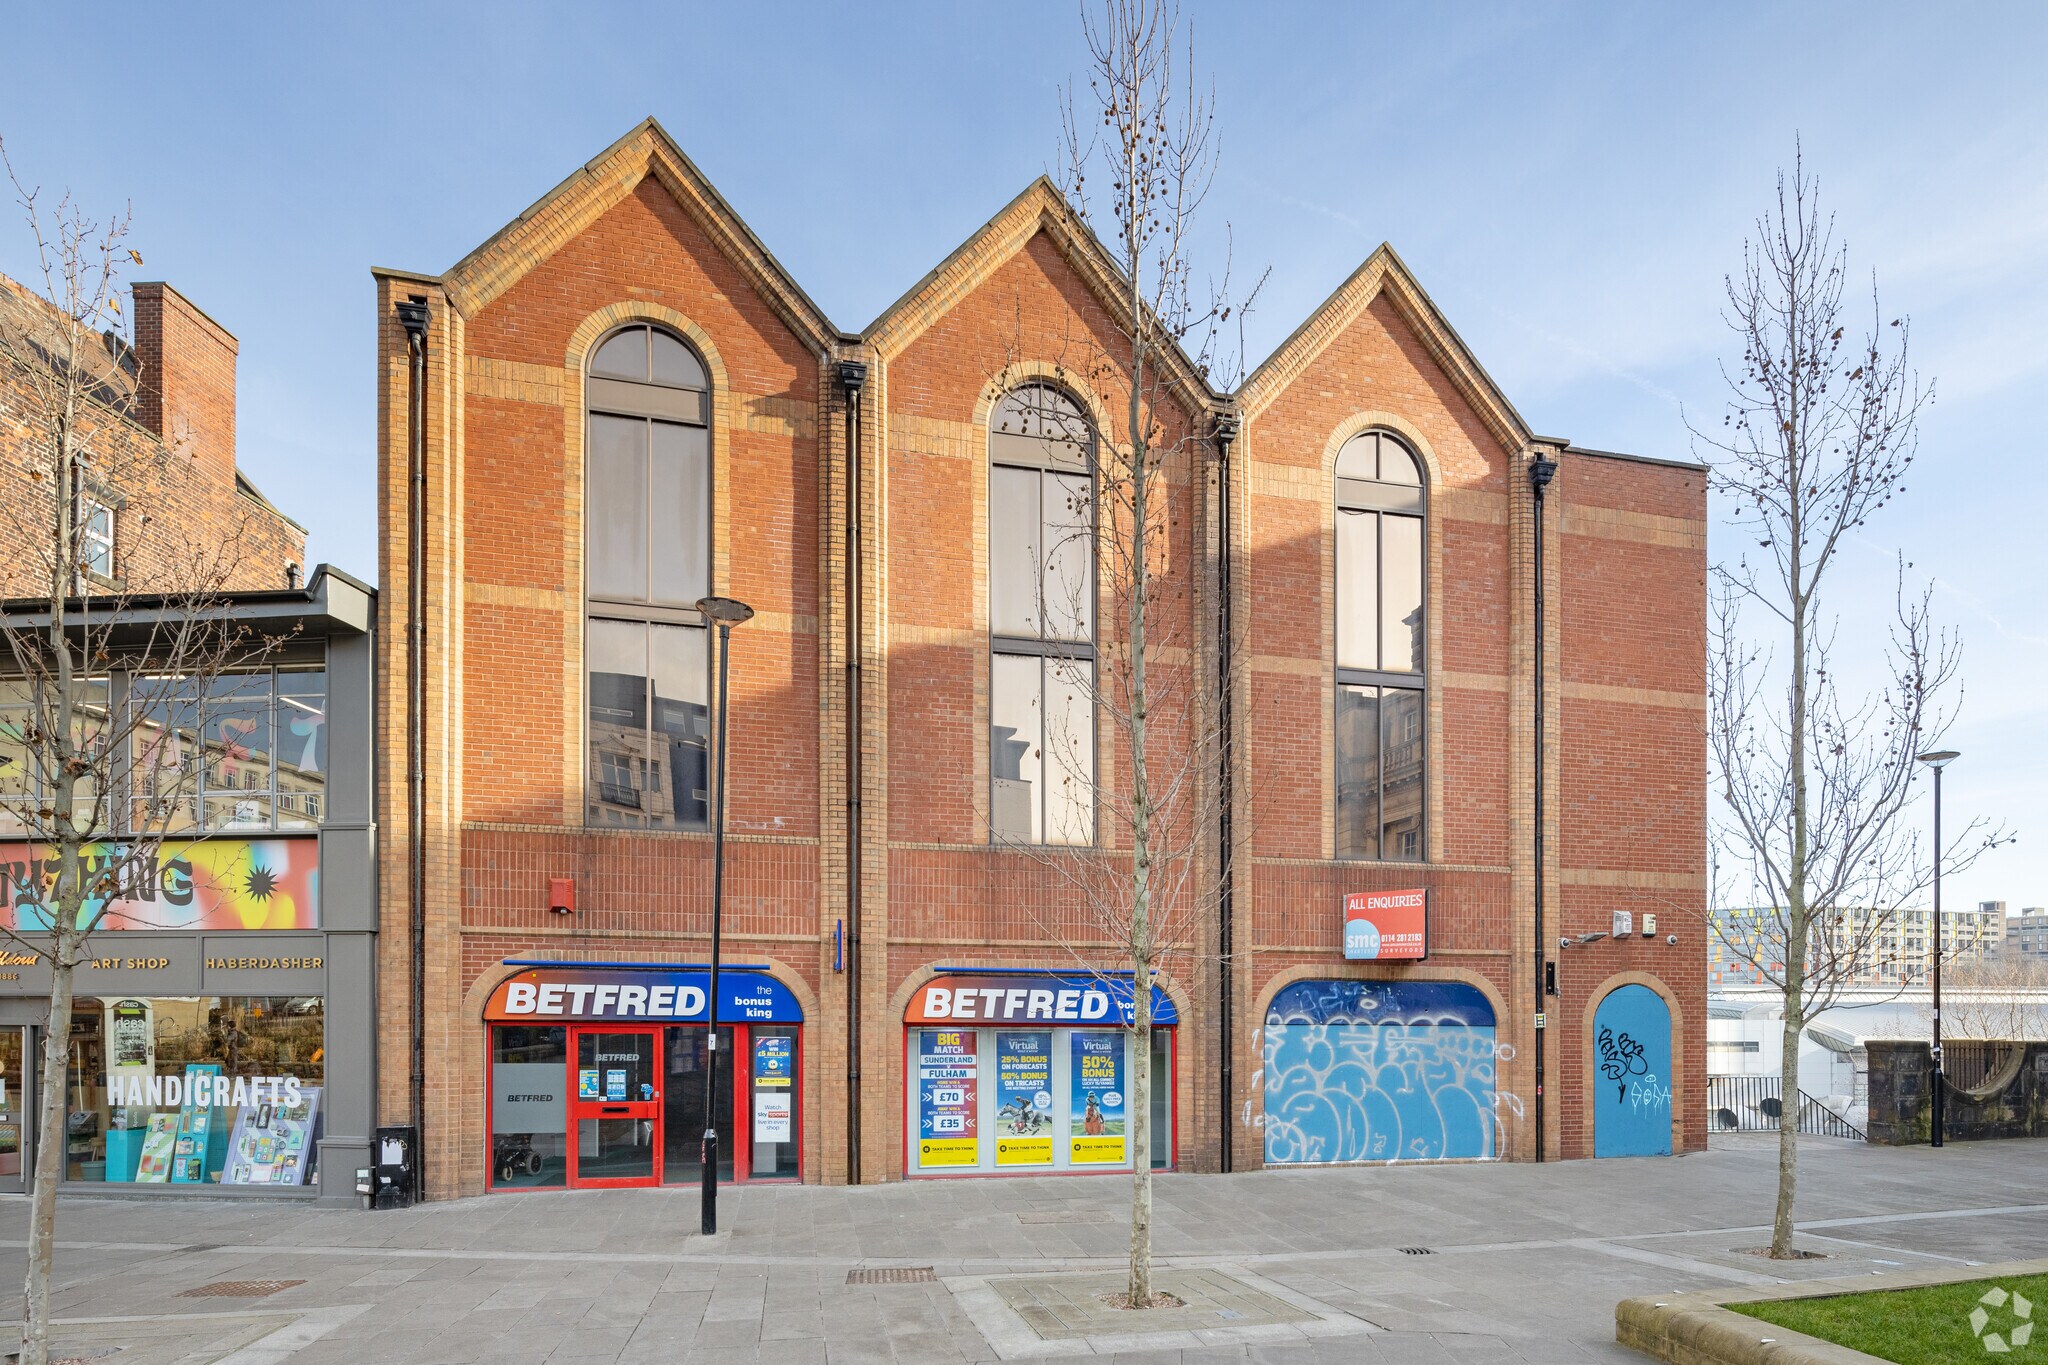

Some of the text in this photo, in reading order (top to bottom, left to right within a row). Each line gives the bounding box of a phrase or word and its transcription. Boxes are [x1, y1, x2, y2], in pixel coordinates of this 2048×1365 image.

[1349, 894, 1422, 910] ALL ENQUIRIES
[1347, 934, 1378, 948] smc
[1381, 934, 1422, 942] 0114 281 2183
[92, 958, 168, 969] ART SHOP
[206, 958, 322, 969] HABERDASHER
[757, 986, 772, 995] the
[505, 982, 706, 1016] BETFRED
[734, 996, 772, 1005] bonus
[924, 988, 1108, 1019] BETFRED
[746, 1008, 772, 1018] king
[937, 1033, 960, 1045] BIG
[1009, 1041, 1038, 1049] Virtual
[1083, 1042, 1112, 1050] Virtual
[595, 1054, 639, 1062] BETFRED
[1082, 1056, 1114, 1068] 50%
[929, 1070, 967, 1078] FULHAM
[1001, 1072, 1019, 1080] 50%
[1082, 1069, 1115, 1077] BONUS
[107, 1075, 302, 1108] HANDICRAFTS
[508, 1094, 553, 1102] BETFRED
[940, 1093, 958, 1101] £70
[940, 1119, 959, 1128] £35
